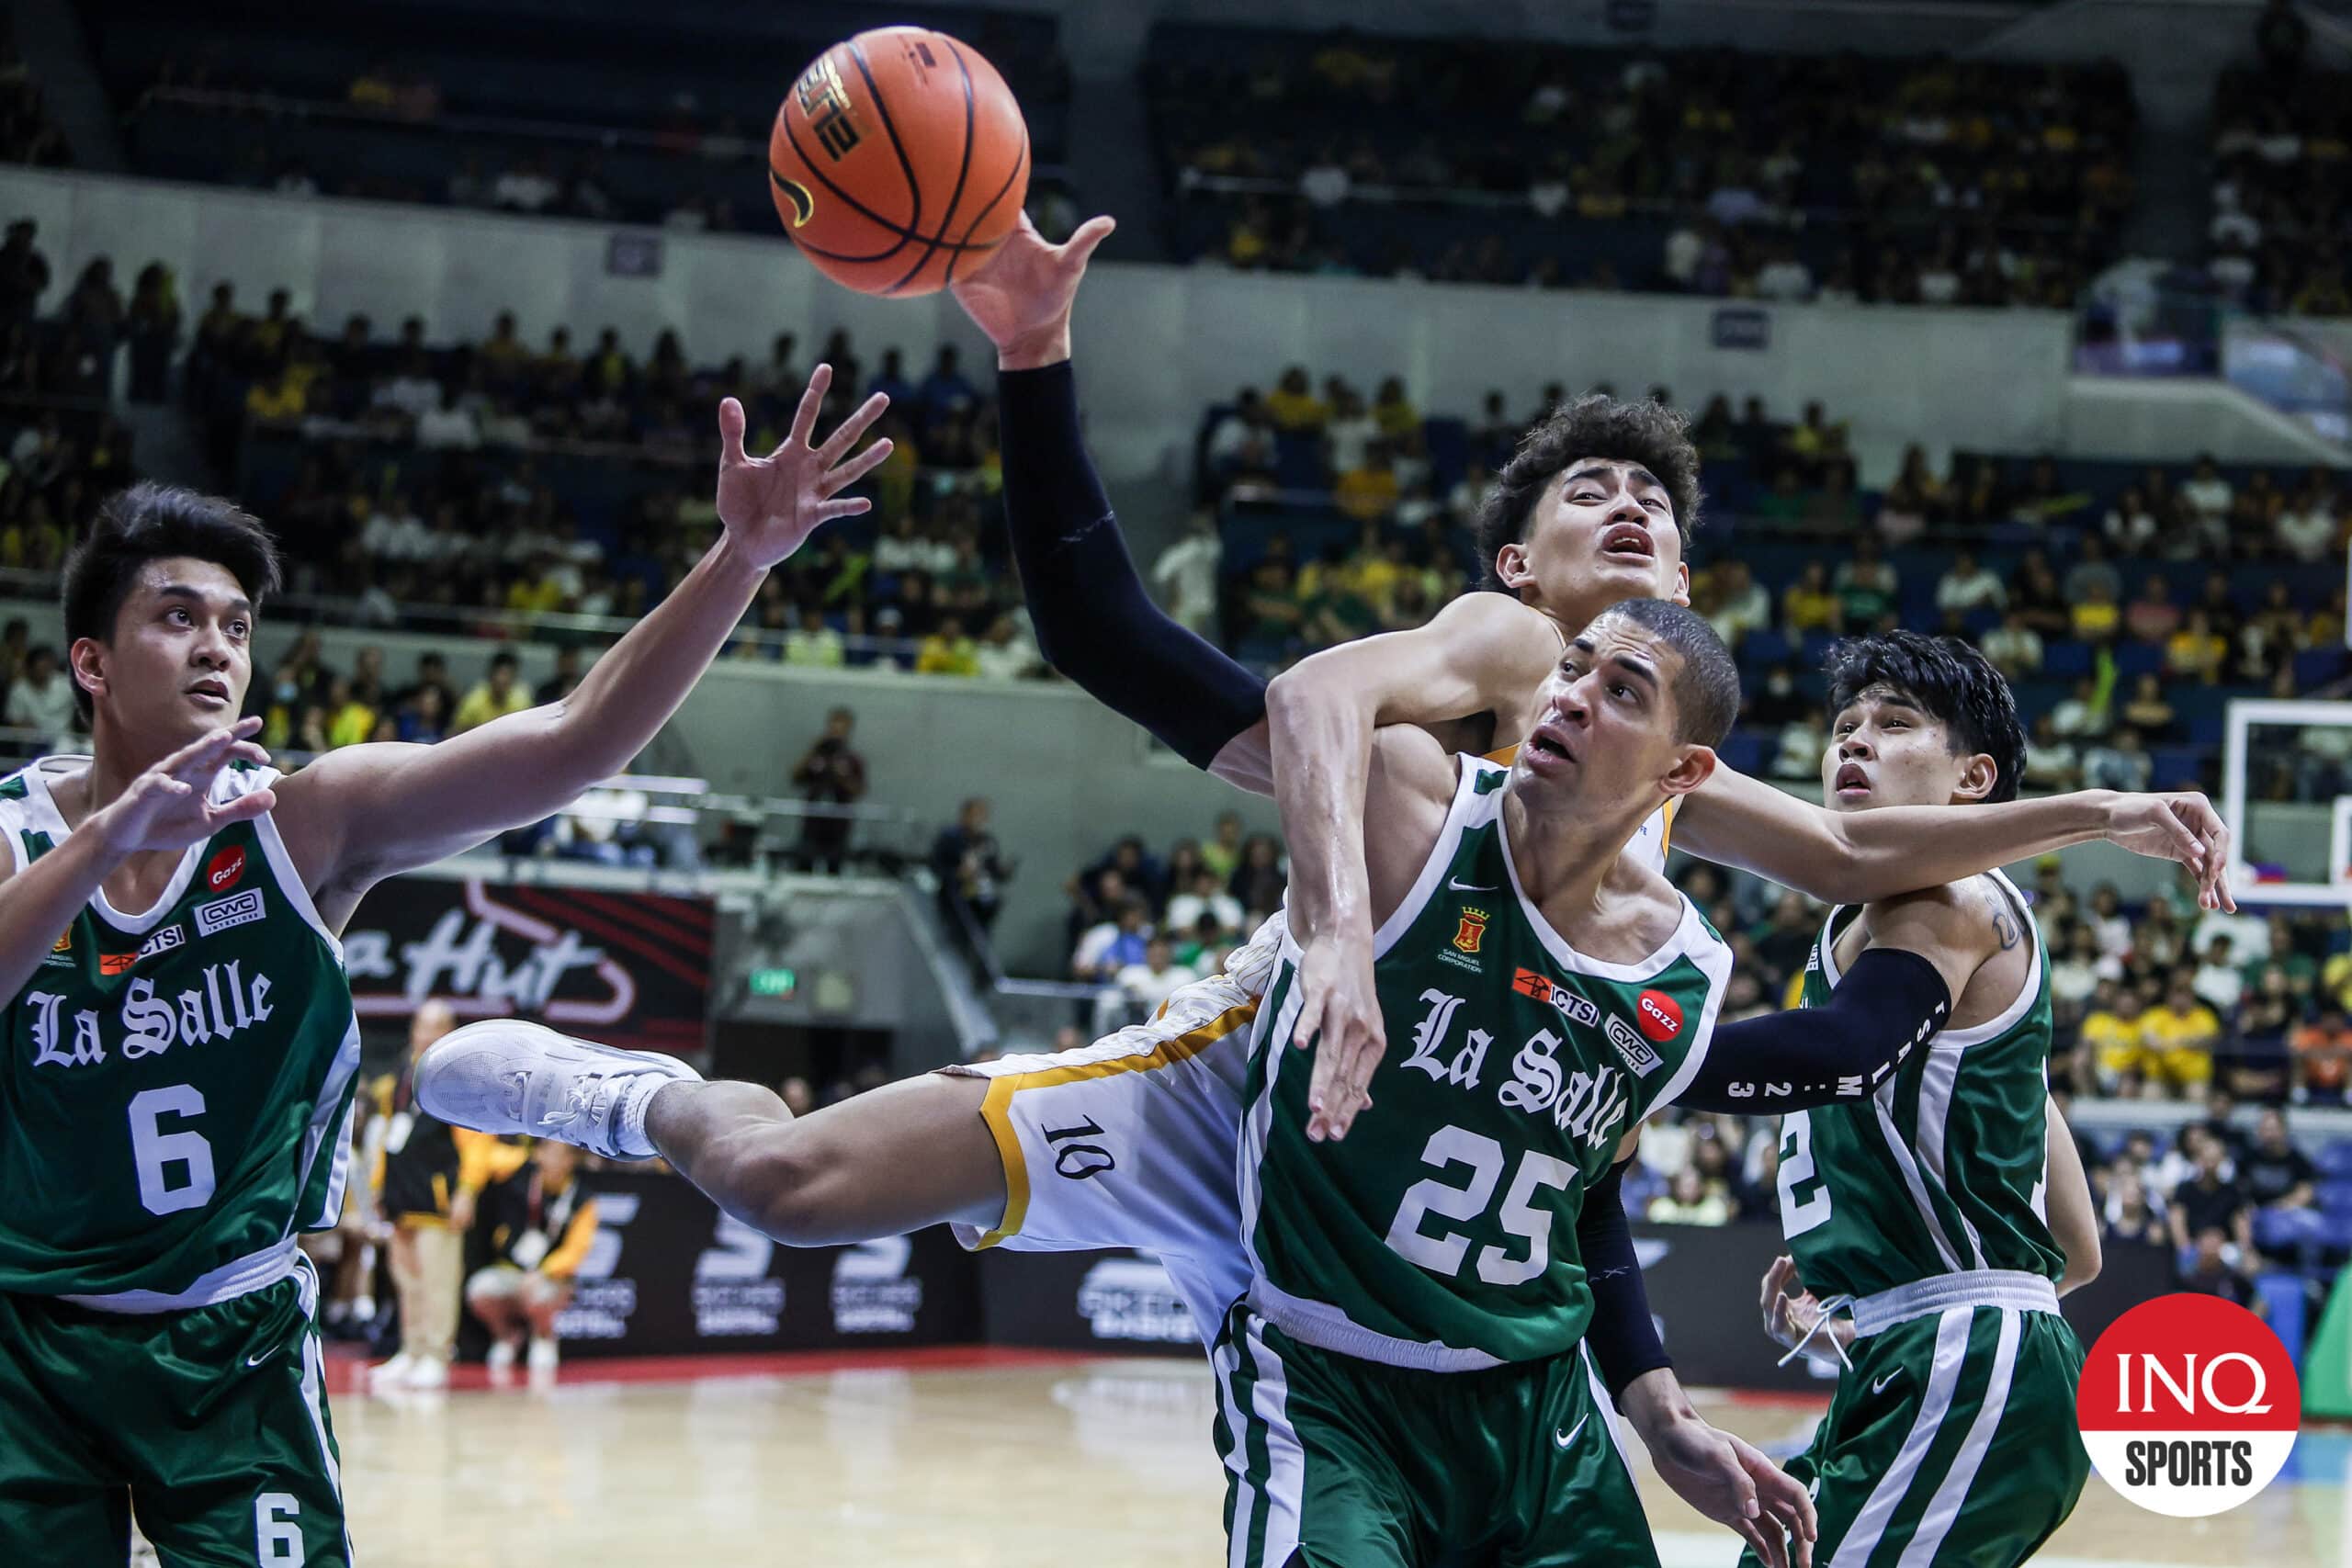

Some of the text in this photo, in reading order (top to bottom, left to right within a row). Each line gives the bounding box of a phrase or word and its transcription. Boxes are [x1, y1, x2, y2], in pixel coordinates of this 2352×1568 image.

[209, 897, 253, 919] CWC
[401, 906, 607, 1010] Hut
[26, 959, 274, 1068] La Salle
[1550, 986, 1599, 1025] ICTSI
[1641, 998, 1679, 1032] Gazz
[1400, 987, 1629, 1151] La Salle
[1612, 1026, 1650, 1062] CWC
[128, 1084, 217, 1216] 6
[1040, 1113, 1116, 1180] 10
[1384, 1123, 1579, 1286] 25
[254, 1493, 306, 1568] 6
